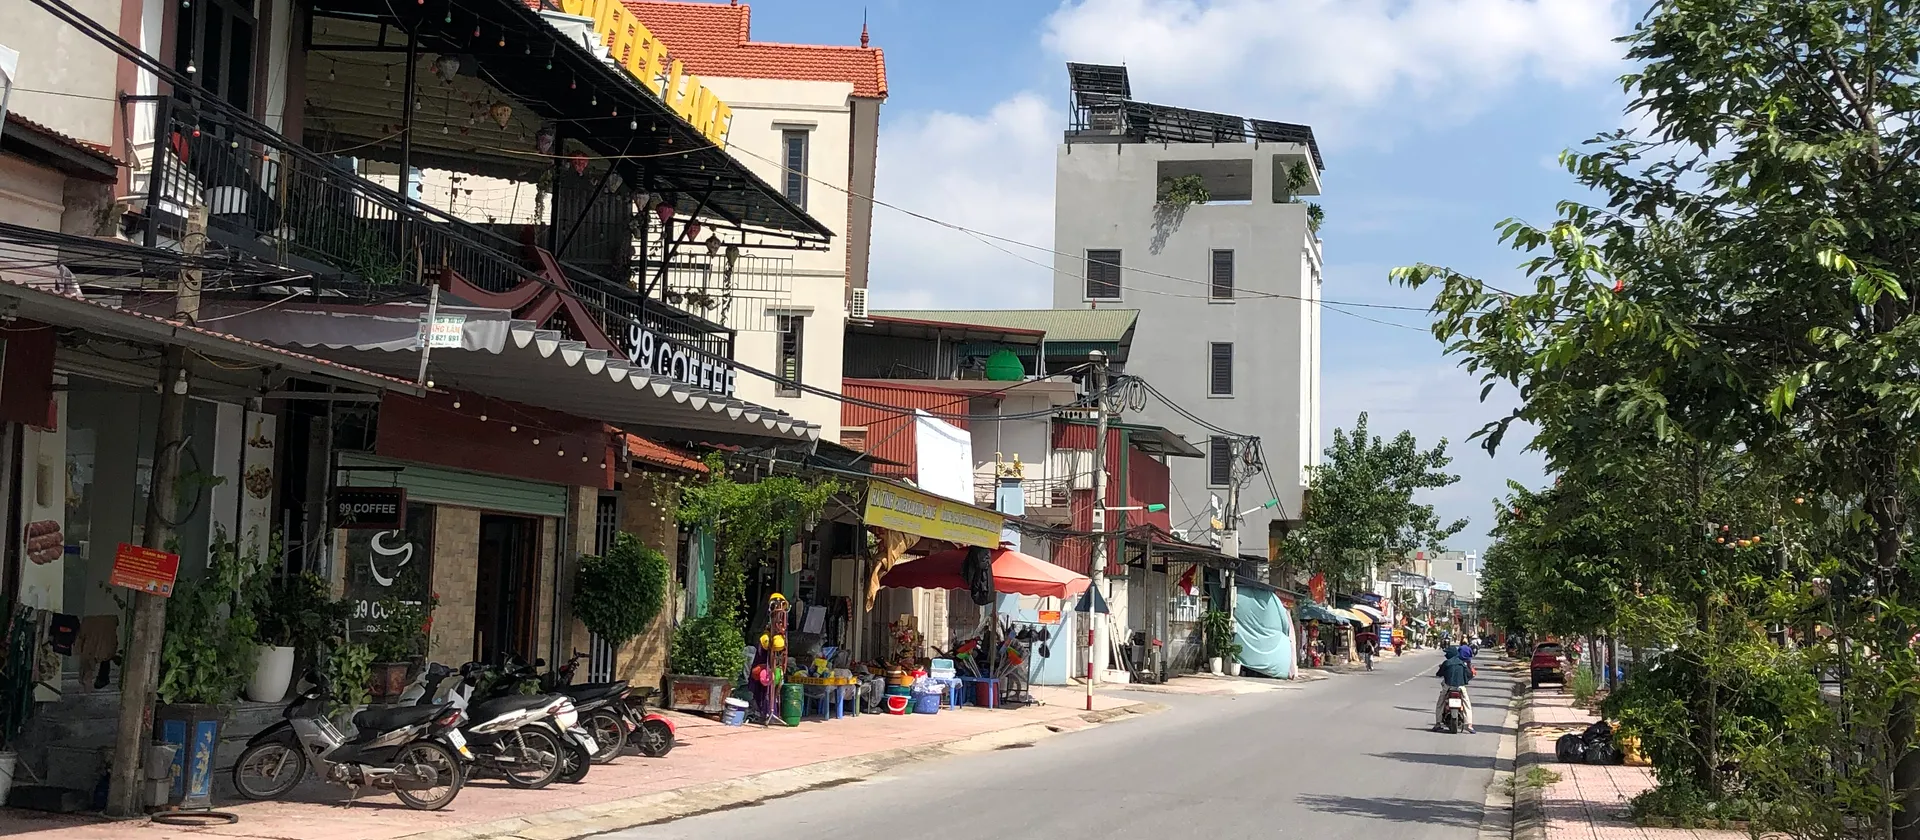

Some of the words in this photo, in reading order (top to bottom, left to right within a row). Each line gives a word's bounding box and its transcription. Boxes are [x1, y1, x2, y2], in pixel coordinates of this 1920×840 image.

[666, 58, 732, 150] LAKE
[629, 318, 655, 370] 99
[340, 503, 351, 513] 99
[353, 503, 396, 514] COFFEE
